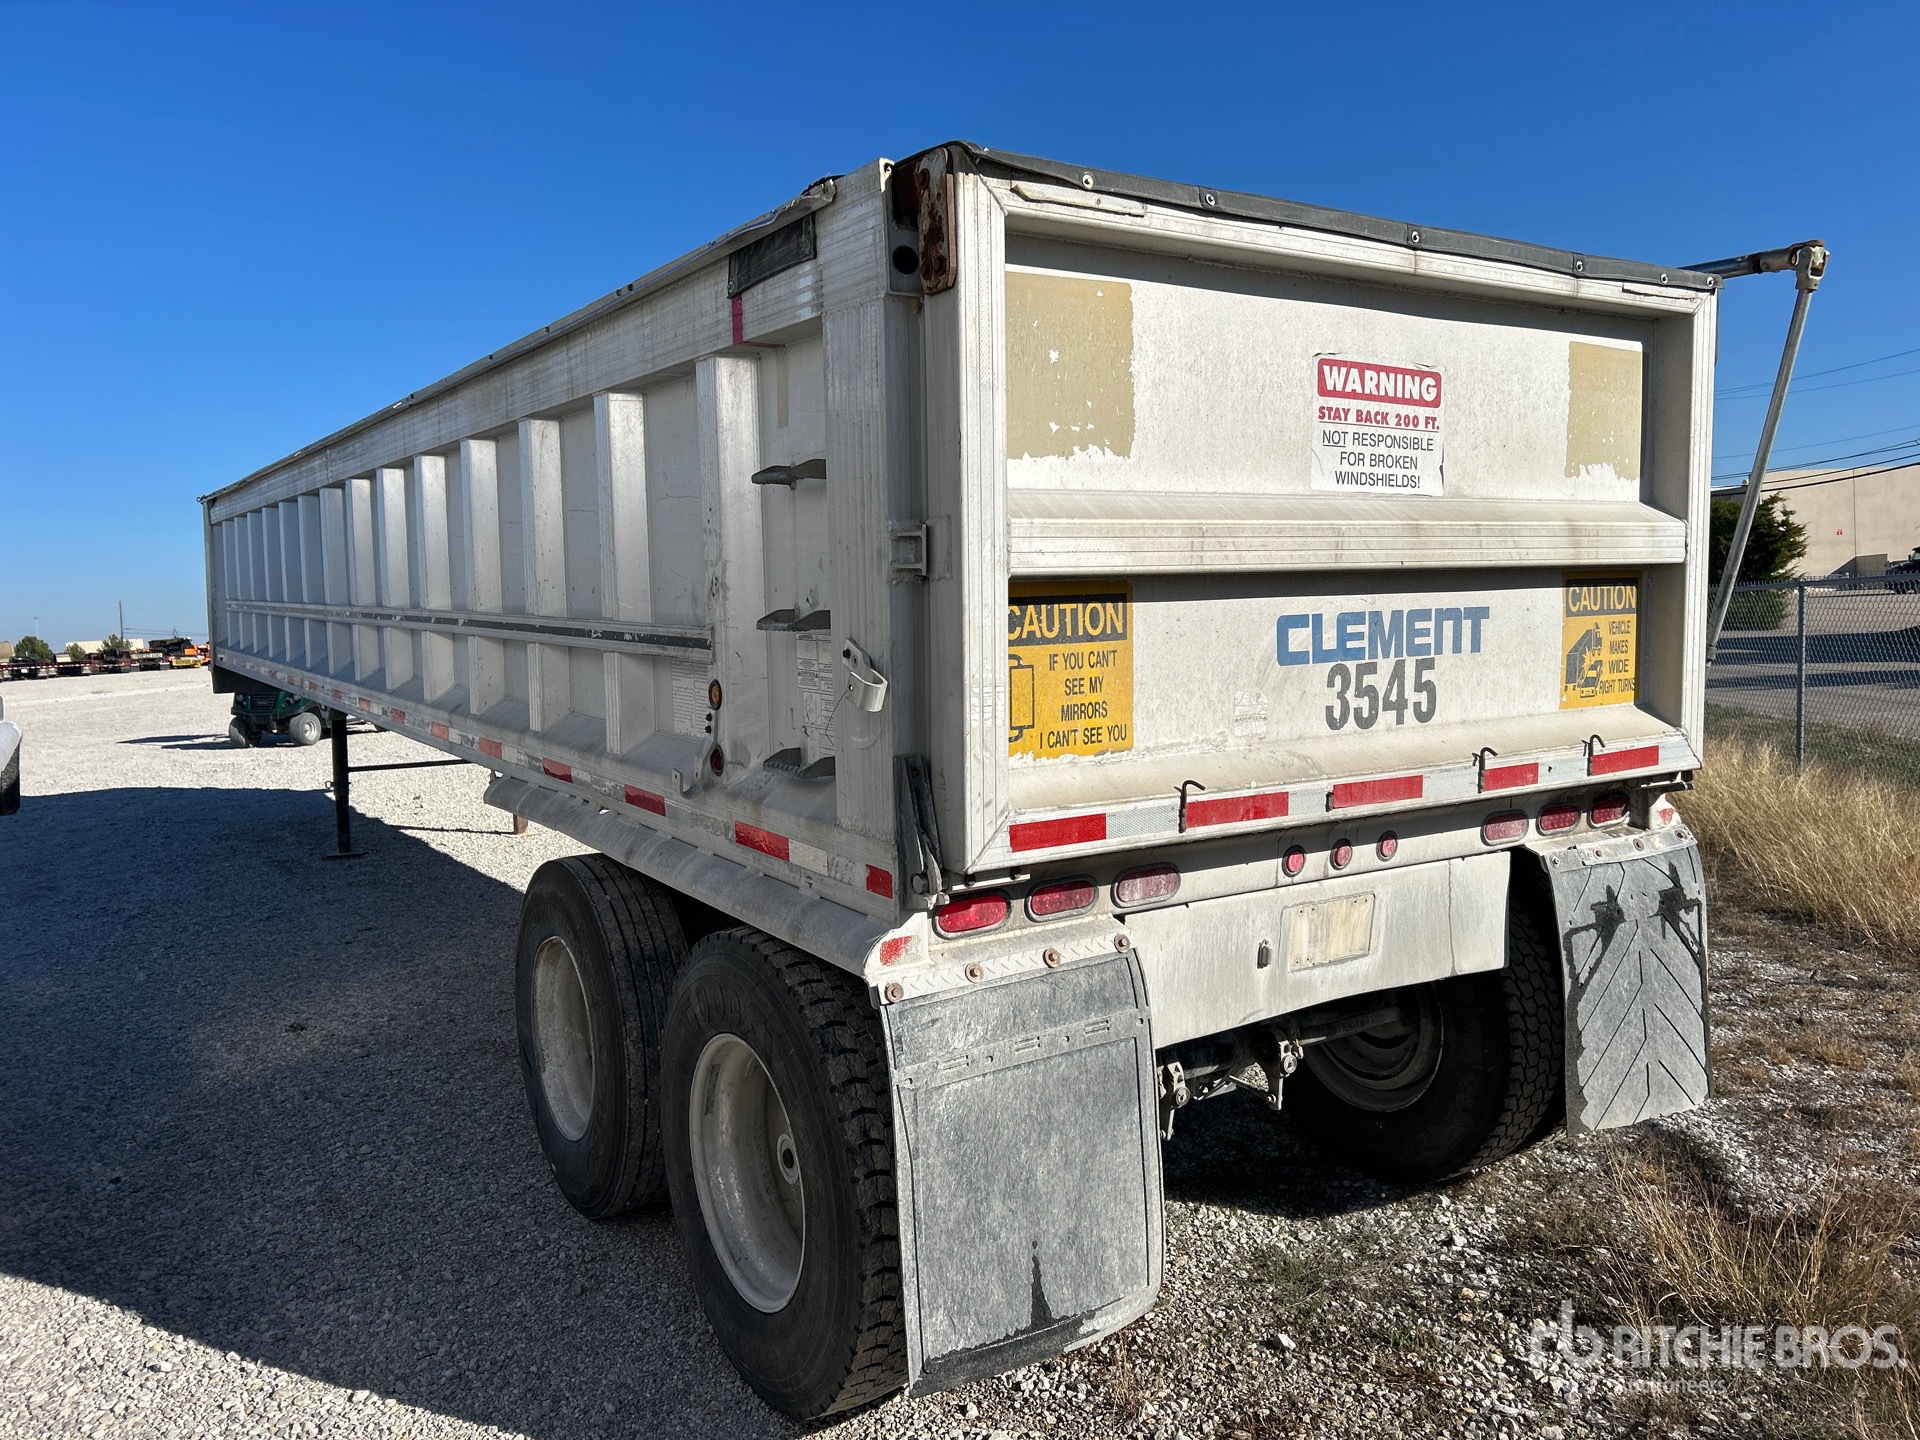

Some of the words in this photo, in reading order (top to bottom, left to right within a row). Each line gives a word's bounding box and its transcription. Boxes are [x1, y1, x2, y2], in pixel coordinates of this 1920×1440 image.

[1322, 365, 1438, 402] WARNING
[1317, 406, 1351, 422] STAY
[1355, 409, 1390, 426] BACK
[1394, 413, 1420, 428] 200
[1424, 416, 1440, 430] FT.
[1322, 430, 1349, 446] NOT
[1352, 432, 1434, 452] RESPONSIBLE
[1340, 451, 1365, 467] FOR
[1369, 454, 1418, 470] BROKEN
[1334, 470, 1421, 489] WINDSHIELDS!
[1568, 582, 1637, 613] CAUTION
[1008, 600, 1124, 641] CAUTION
[1608, 620, 1631, 635] VEHICLE
[1276, 606, 1490, 667] CLEMENT
[1609, 639, 1629, 654] MAKES
[1049, 653, 1059, 671] IF
[1062, 652, 1084, 671] YOU
[1088, 650, 1118, 669] CAN'T
[1608, 659, 1629, 674] WIDE
[1064, 677, 1085, 696] SEE
[1089, 676, 1104, 694] MY
[1325, 657, 1437, 731] 3545
[1598, 680, 1616, 696] RIGHT
[1060, 701, 1108, 722] MIRRORS
[1047, 729, 1079, 748] CAN'T
[1082, 726, 1103, 746] SEE
[1107, 724, 1127, 742] YOU
